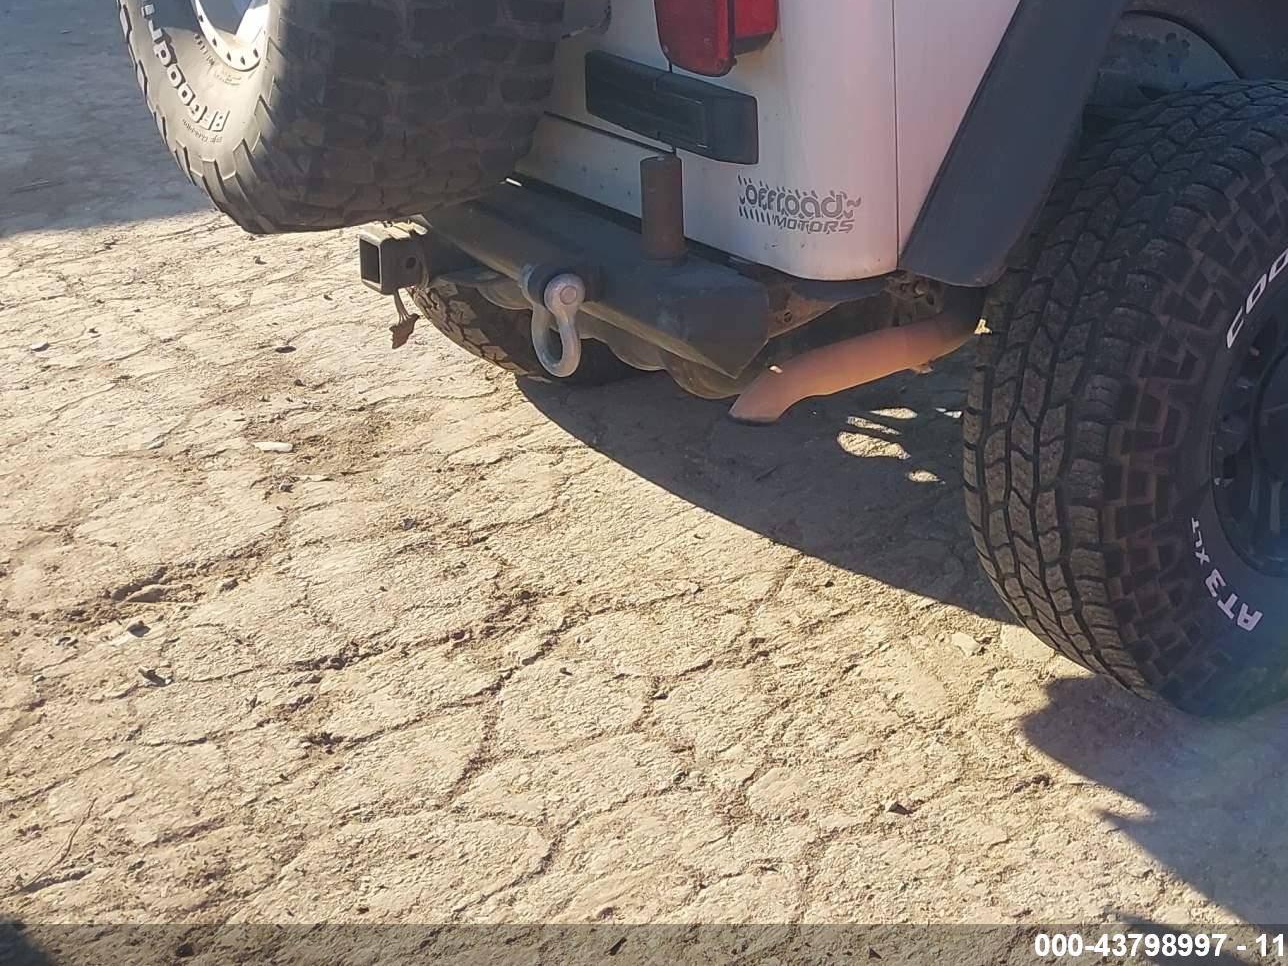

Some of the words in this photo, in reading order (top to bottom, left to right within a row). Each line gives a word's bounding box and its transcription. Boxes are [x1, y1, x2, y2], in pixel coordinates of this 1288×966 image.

[772, 214, 856, 234] MOTORS
[1191, 517, 1211, 566] XLT
[1205, 568, 1264, 631] AT3
